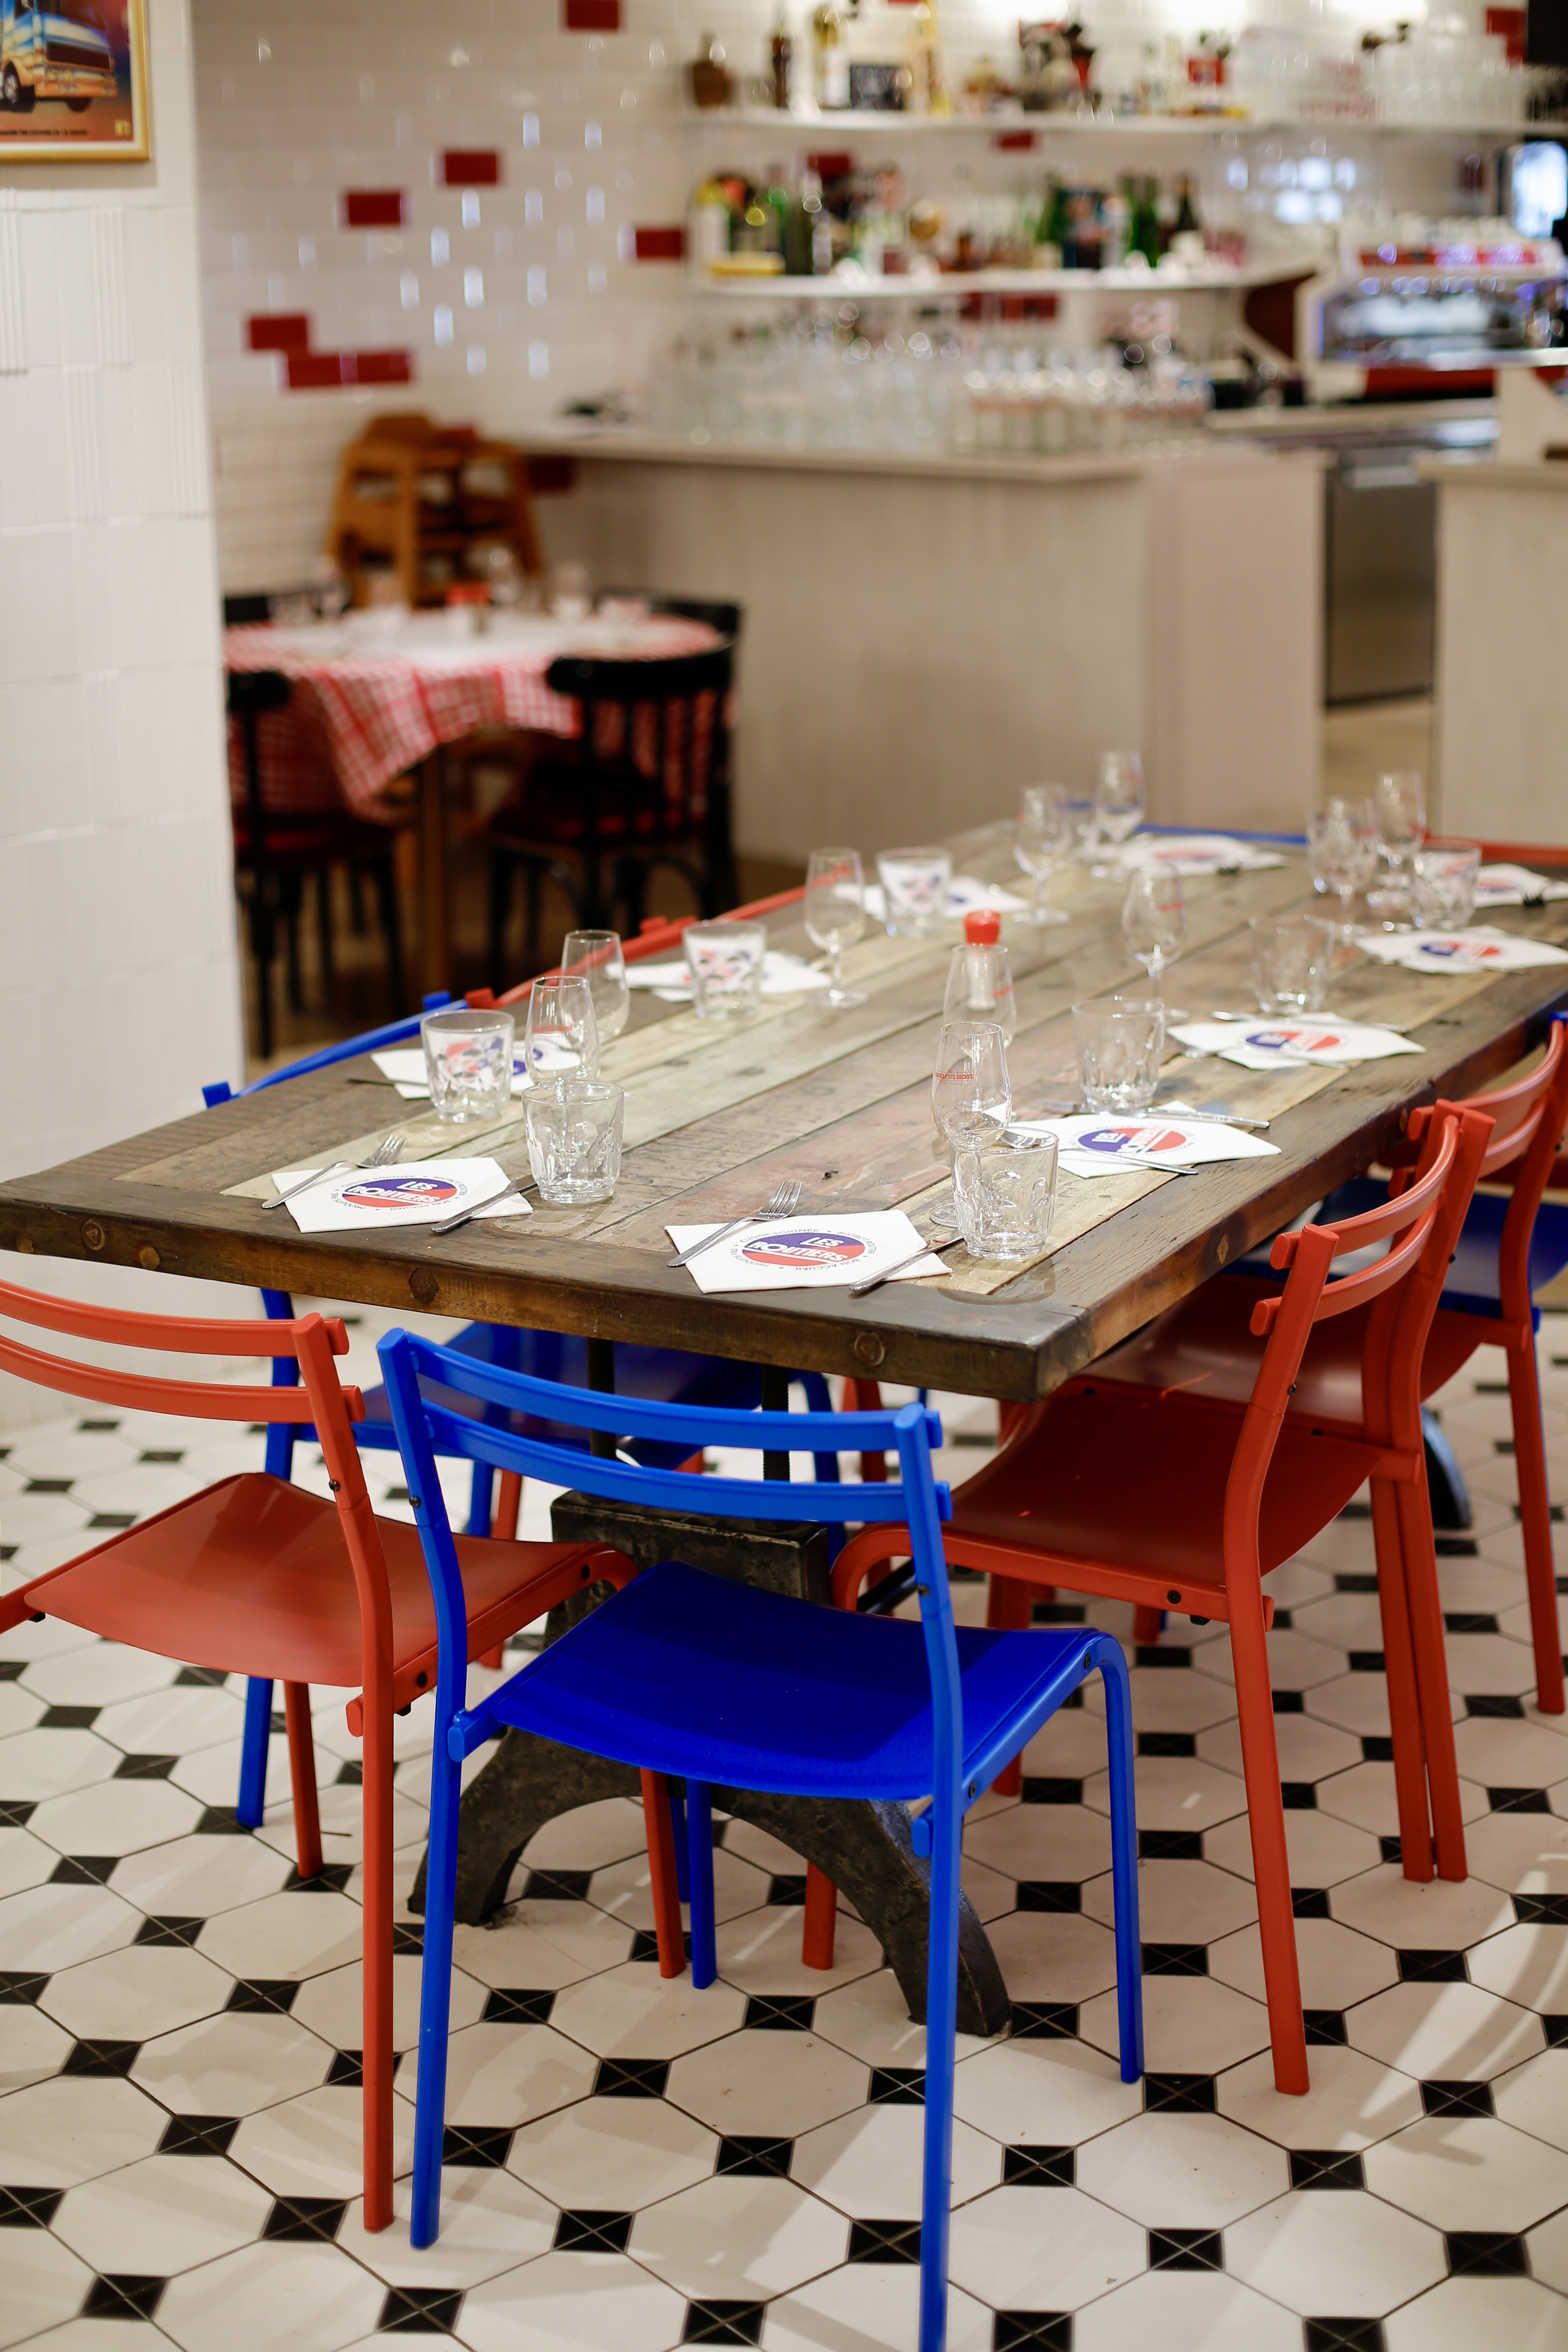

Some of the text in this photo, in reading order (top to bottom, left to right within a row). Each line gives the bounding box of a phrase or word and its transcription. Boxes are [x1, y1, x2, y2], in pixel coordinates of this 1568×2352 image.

[396, 1180, 438, 1192] LES
[347, 1185, 441, 1203] ROUTIERS
[739, 1233, 771, 1243] CUISINE
[799, 1236, 845, 1248] LES
[837, 1232, 877, 1254] BISTROT ROUTIER
[746, 1241, 849, 1262] ROUTIERS
